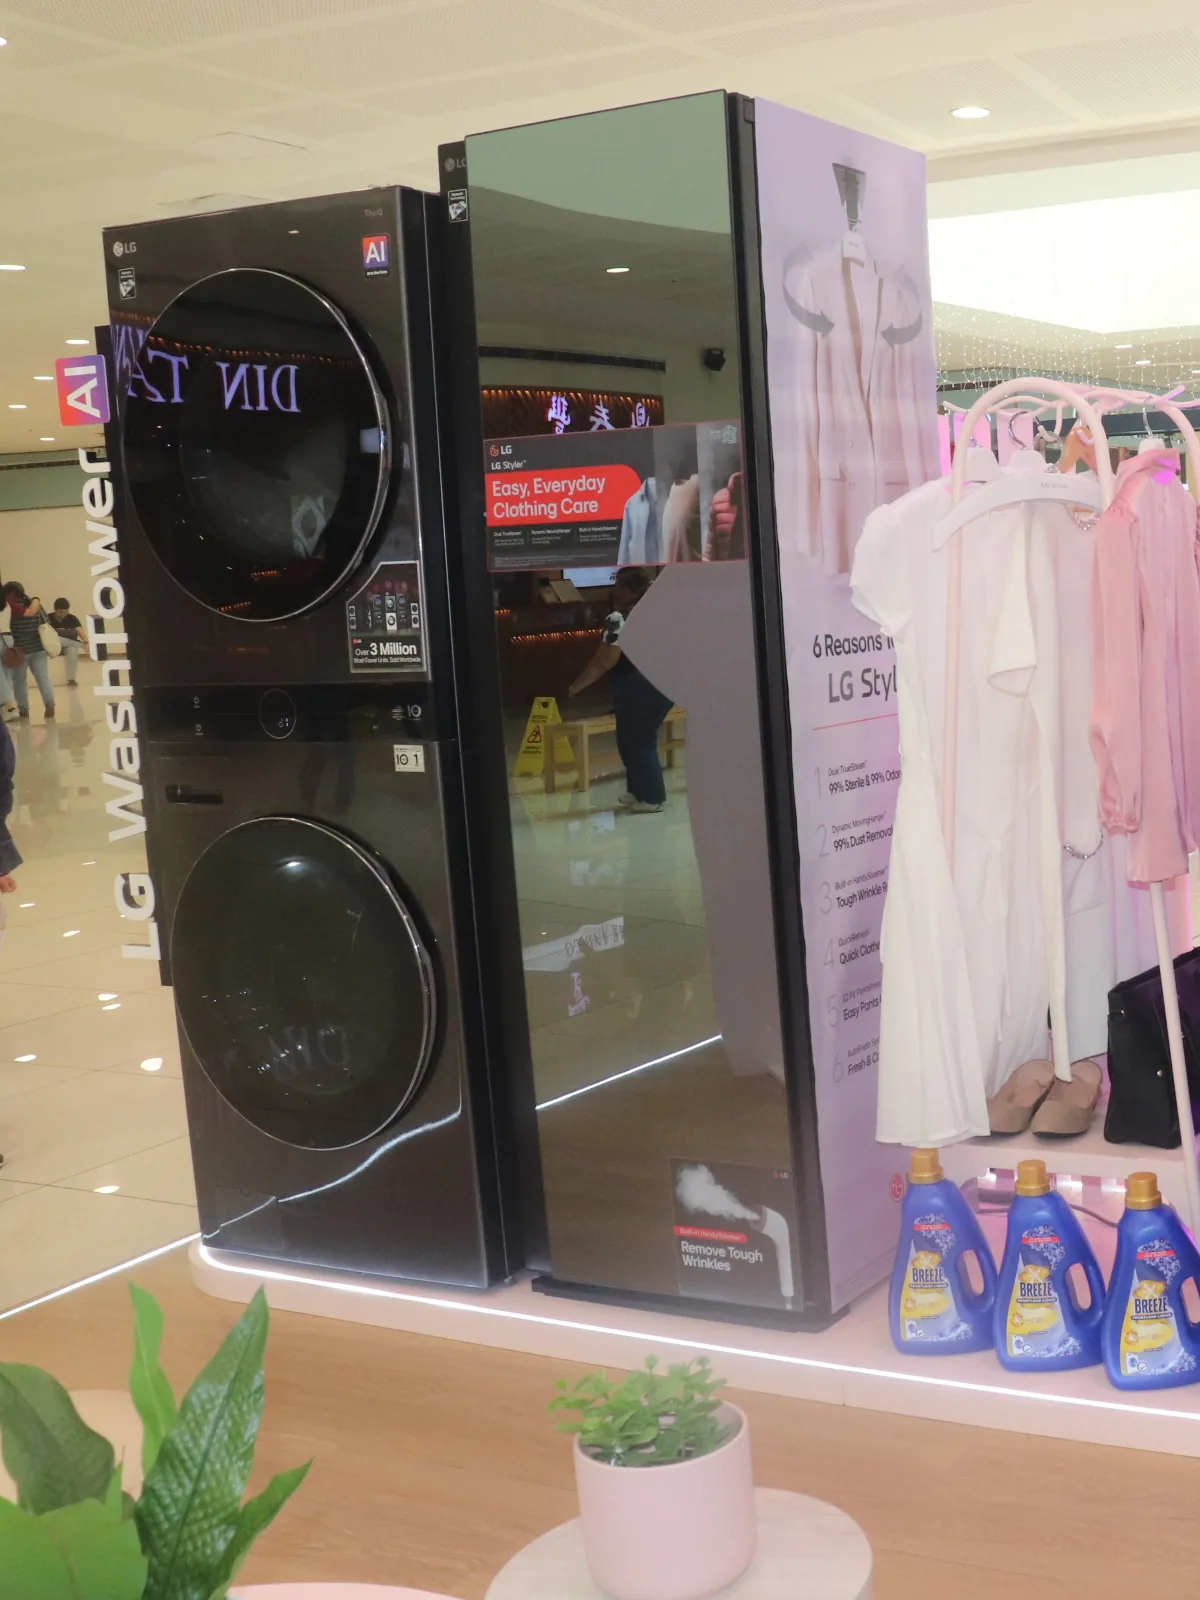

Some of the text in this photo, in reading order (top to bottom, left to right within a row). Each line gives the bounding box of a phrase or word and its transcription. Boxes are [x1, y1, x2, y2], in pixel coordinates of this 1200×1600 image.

[124, 242, 137, 254] LG
[365, 241, 385, 263] AI
[64, 365, 101, 418] AI
[500, 445, 512, 454] LG
[491, 462, 501, 470] LG
[492, 475, 606, 499] Easy, Everyday
[493, 498, 599, 519] Clothing Care
[355, 642, 417, 656] Over 3 Million
[813, 635, 822, 658] 6
[824, 634, 883, 657] Reasons
[828, 665, 898, 703] LG Styl
[78, 448, 161, 961] LG WashTower
[396, 753, 419, 766] 10 1
[844, 777, 865, 791] Sterile
[871, 771, 885, 785] 99%
[850, 833, 866, 848] Dust
[836, 892, 857, 909] Tough
[857, 886, 882, 903] Wrinkle
[839, 947, 859, 965] Quick
[843, 997, 879, 1021] Easy Pants
[681, 1241, 763, 1264] Remove Tough
[682, 1254, 731, 1272] Wrinkles
[912, 1267, 944, 1283] BREEZE
[1019, 1282, 1053, 1298] BREEZE
[1134, 1297, 1168, 1314] BREEZE
